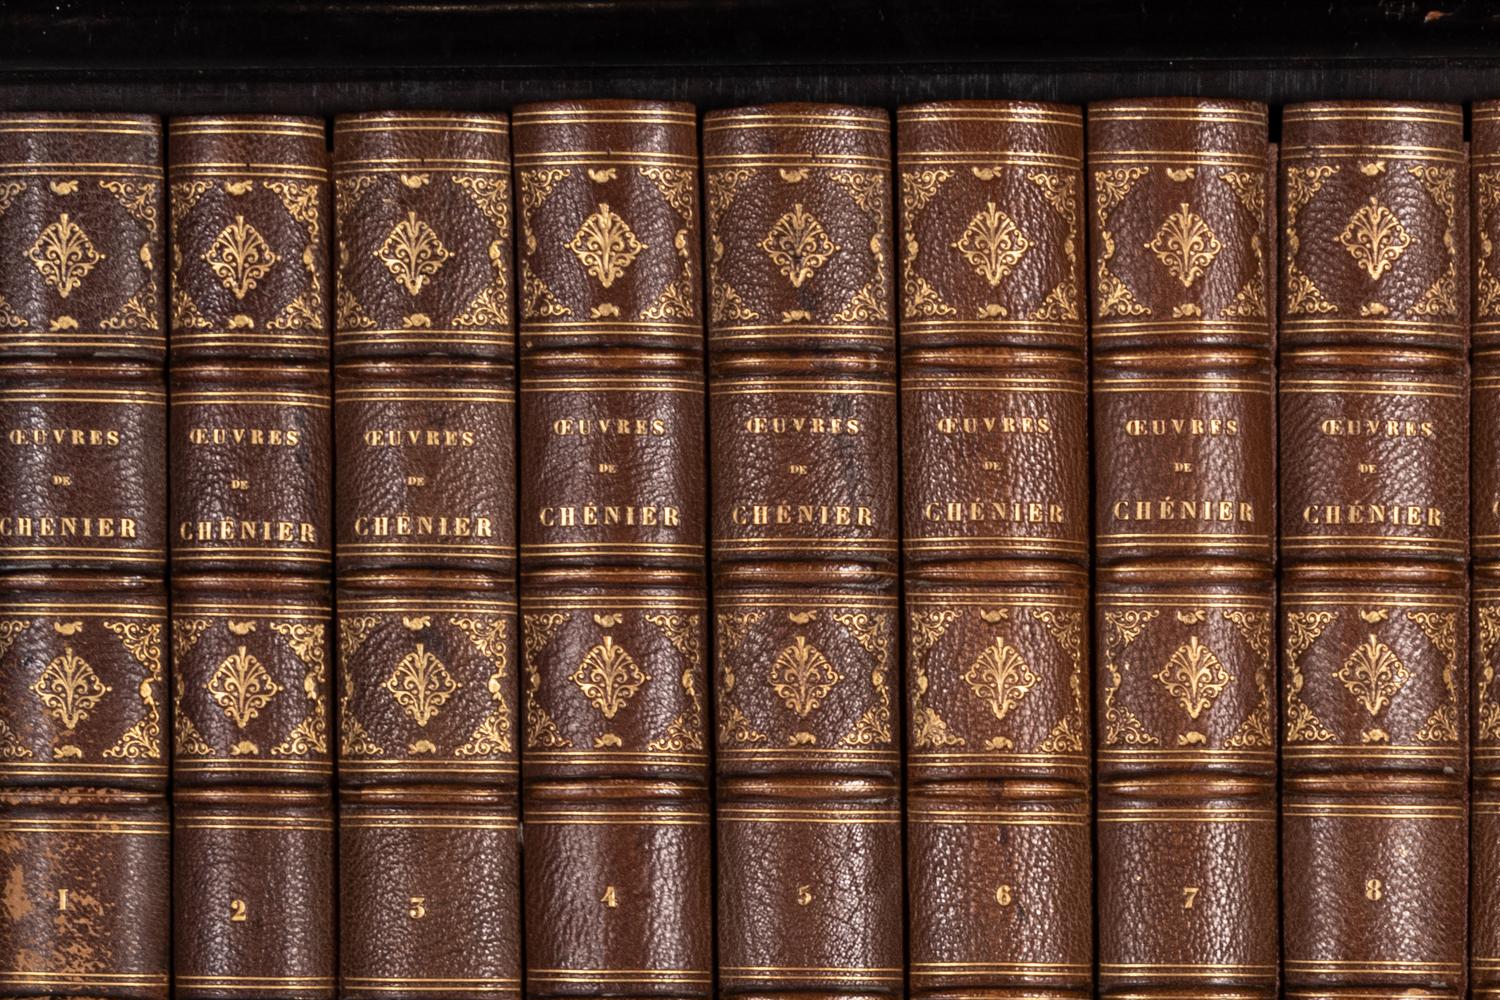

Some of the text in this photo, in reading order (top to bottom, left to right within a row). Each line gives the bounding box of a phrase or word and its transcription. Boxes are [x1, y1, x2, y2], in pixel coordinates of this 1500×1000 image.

[554, 419, 664, 436] ŒUVRES
[747, 418, 859, 435] ŒUVRES
[938, 417, 1049, 435] ŒUVRES
[1126, 419, 1237, 436] ŒUVRES
[1322, 419, 1432, 438] ŒUVRES
[9, 429, 120, 447] ŒUVRES
[190, 429, 300, 446] ŒUVRES
[365, 429, 475, 447] ŒUVRES
[599, 463, 616, 474] DE
[790, 465, 807, 474] DE
[984, 461, 1001, 471] DE
[1174, 462, 1192, 472] DE
[1360, 464, 1376, 474] DE
[54, 475, 71, 486] DE
[232, 479, 248, 489] DE
[408, 476, 424, 486] DE
[540, 502, 679, 528] CHÉNIER
[733, 498, 872, 526] CHÉNIER
[926, 499, 1063, 524] CHÉNIER
[1114, 497, 1253, 522] CHÉNIER
[1304, 501, 1442, 528] CHÉNIER
[354, 514, 492, 538] CHÉNIER
[601, 886, 618, 908] 4
[798, 885, 812, 906] 5
[996, 885, 1011, 906] 6
[1182, 888, 1198, 909] 7
[1367, 879, 1382, 901] 8
[58, 889, 69, 910] 1
[409, 897, 426, 919] 3
[231, 899, 247, 921] 2
